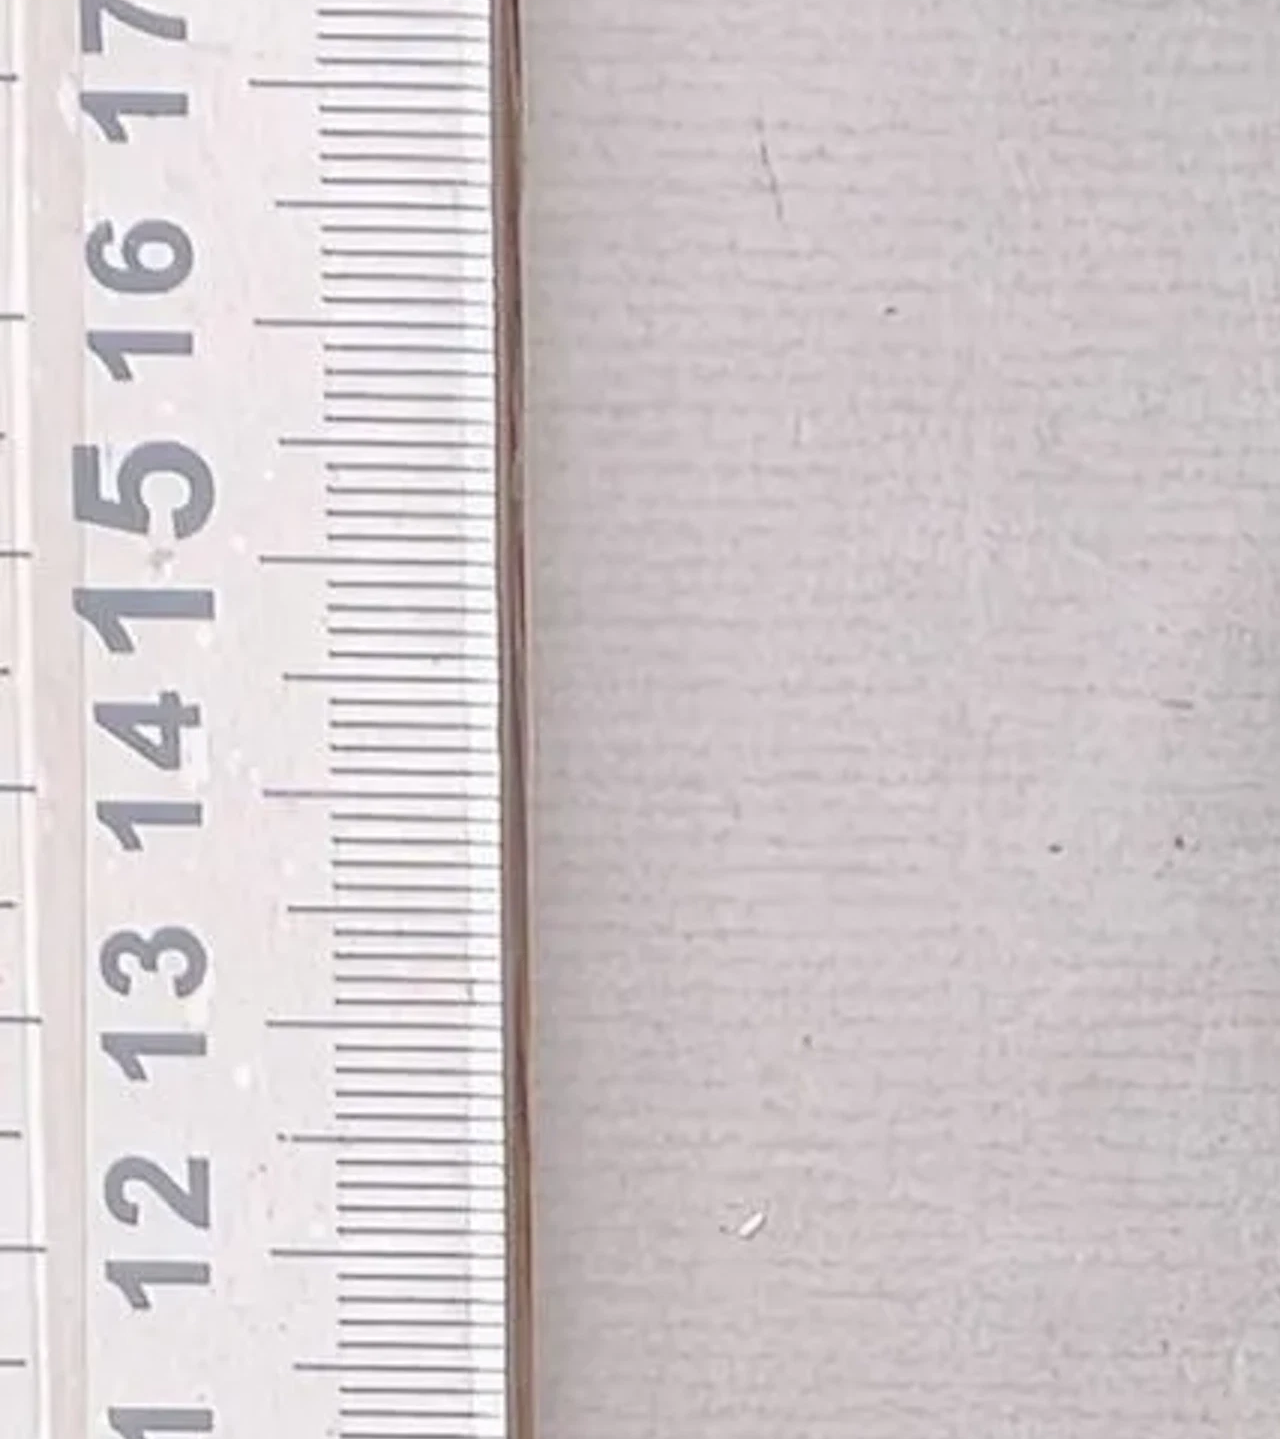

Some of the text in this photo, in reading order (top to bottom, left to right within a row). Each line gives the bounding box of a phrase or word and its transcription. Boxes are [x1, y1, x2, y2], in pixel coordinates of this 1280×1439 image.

[84, 220, 194, 383] 16
[71, 441, 215, 655] 15
[93, 690, 203, 852] 14
[99, 927, 208, 1082] 13
[104, 1156, 211, 1311] 12
